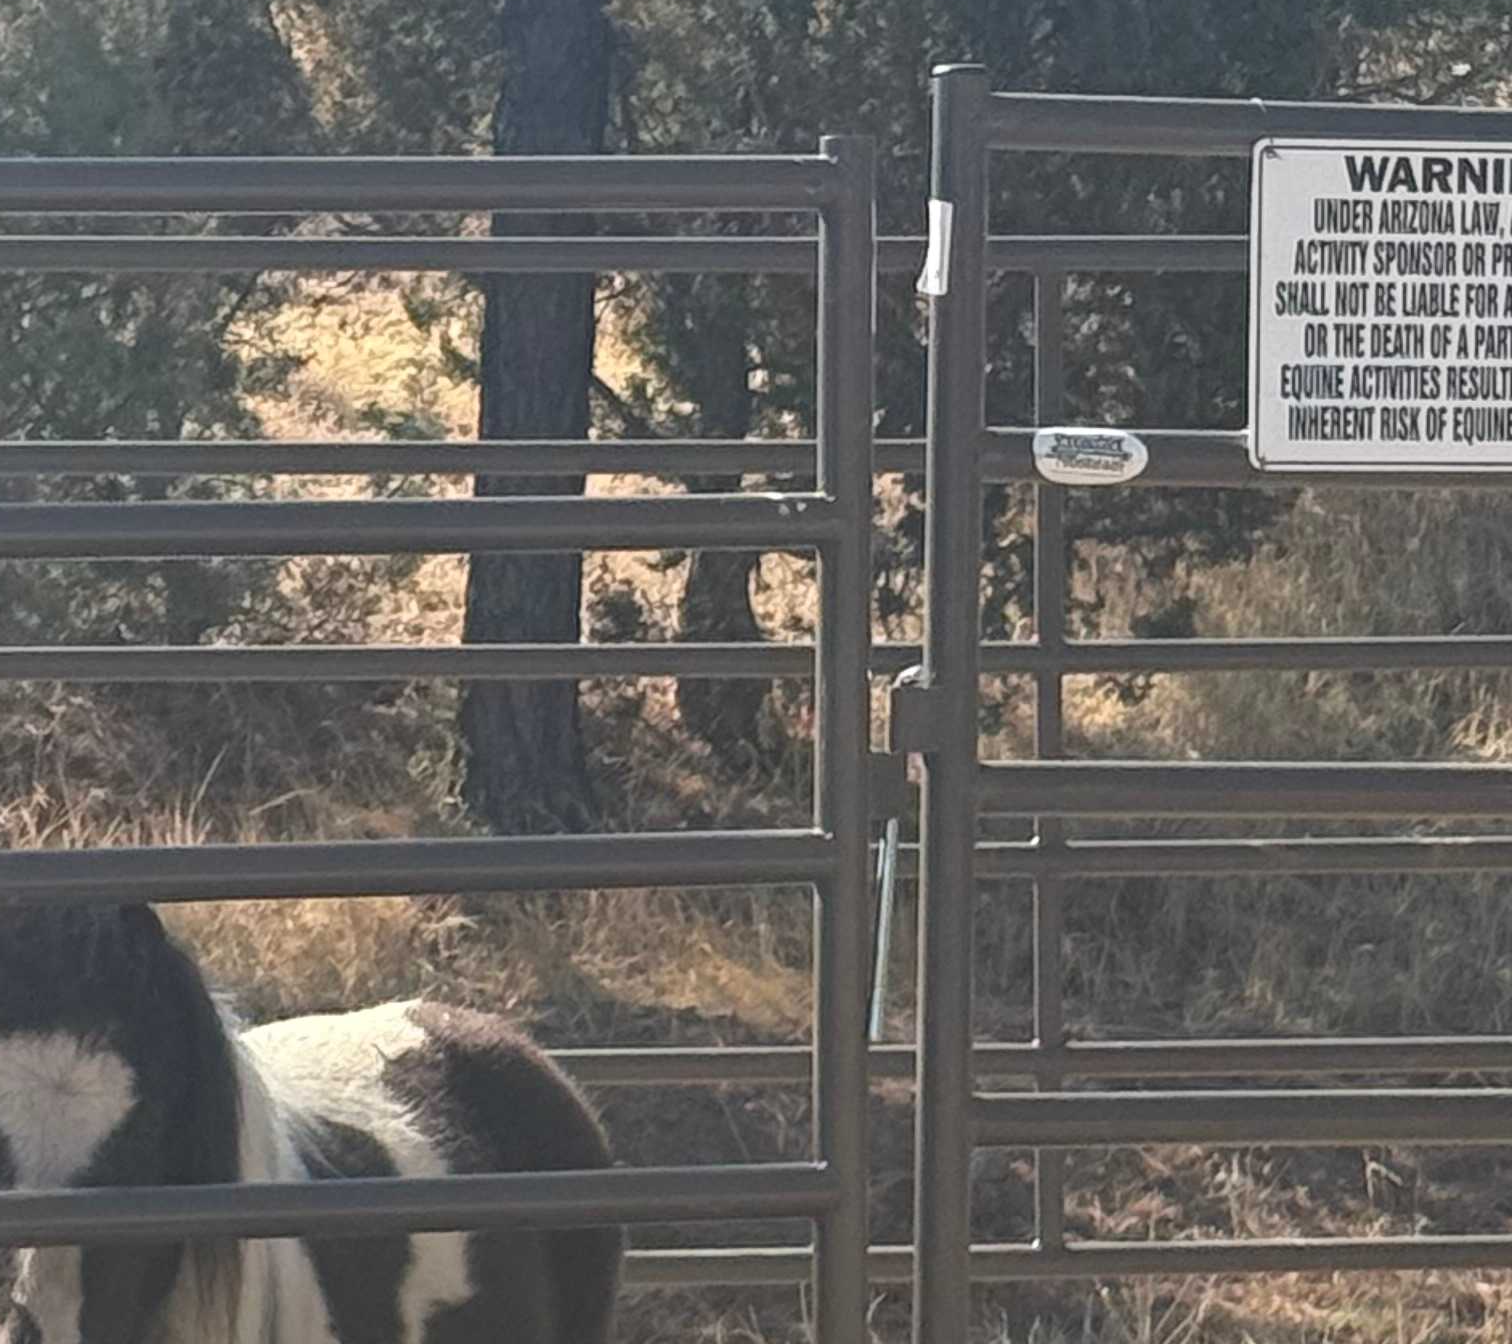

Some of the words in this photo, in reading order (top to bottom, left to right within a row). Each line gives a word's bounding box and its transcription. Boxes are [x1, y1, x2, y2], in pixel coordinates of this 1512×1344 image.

[1344, 155, 1512, 195] WARNI
[1314, 198, 1373, 234] UNDER
[1378, 198, 1455, 235] ARIZONA
[1460, 200, 1505, 238] LAW,
[1294, 239, 1369, 276] ACTIVITY
[1373, 240, 1457, 277] SPONSOR
[1462, 241, 1486, 277] OR
[1275, 280, 1330, 317] SHALL
[1334, 281, 1370, 317] NOT
[1374, 281, 1397, 317] BE
[1402, 282, 1461, 318] LIABLE
[1465, 283, 1499, 319] FOR
[1304, 322, 1328, 358] OR
[1333, 323, 1366, 359] THE
[1370, 323, 1425, 359] DEATH
[1430, 323, 1452, 359] OF
[1456, 324, 1469, 359] A
[1280, 363, 1345, 402] EQUINE
[1349, 364, 1441, 401] ACTIVITIES
[1288, 405, 1376, 441] INHERENT
[1380, 405, 1421, 442] RISK
[1425, 406, 1448, 442] OF
